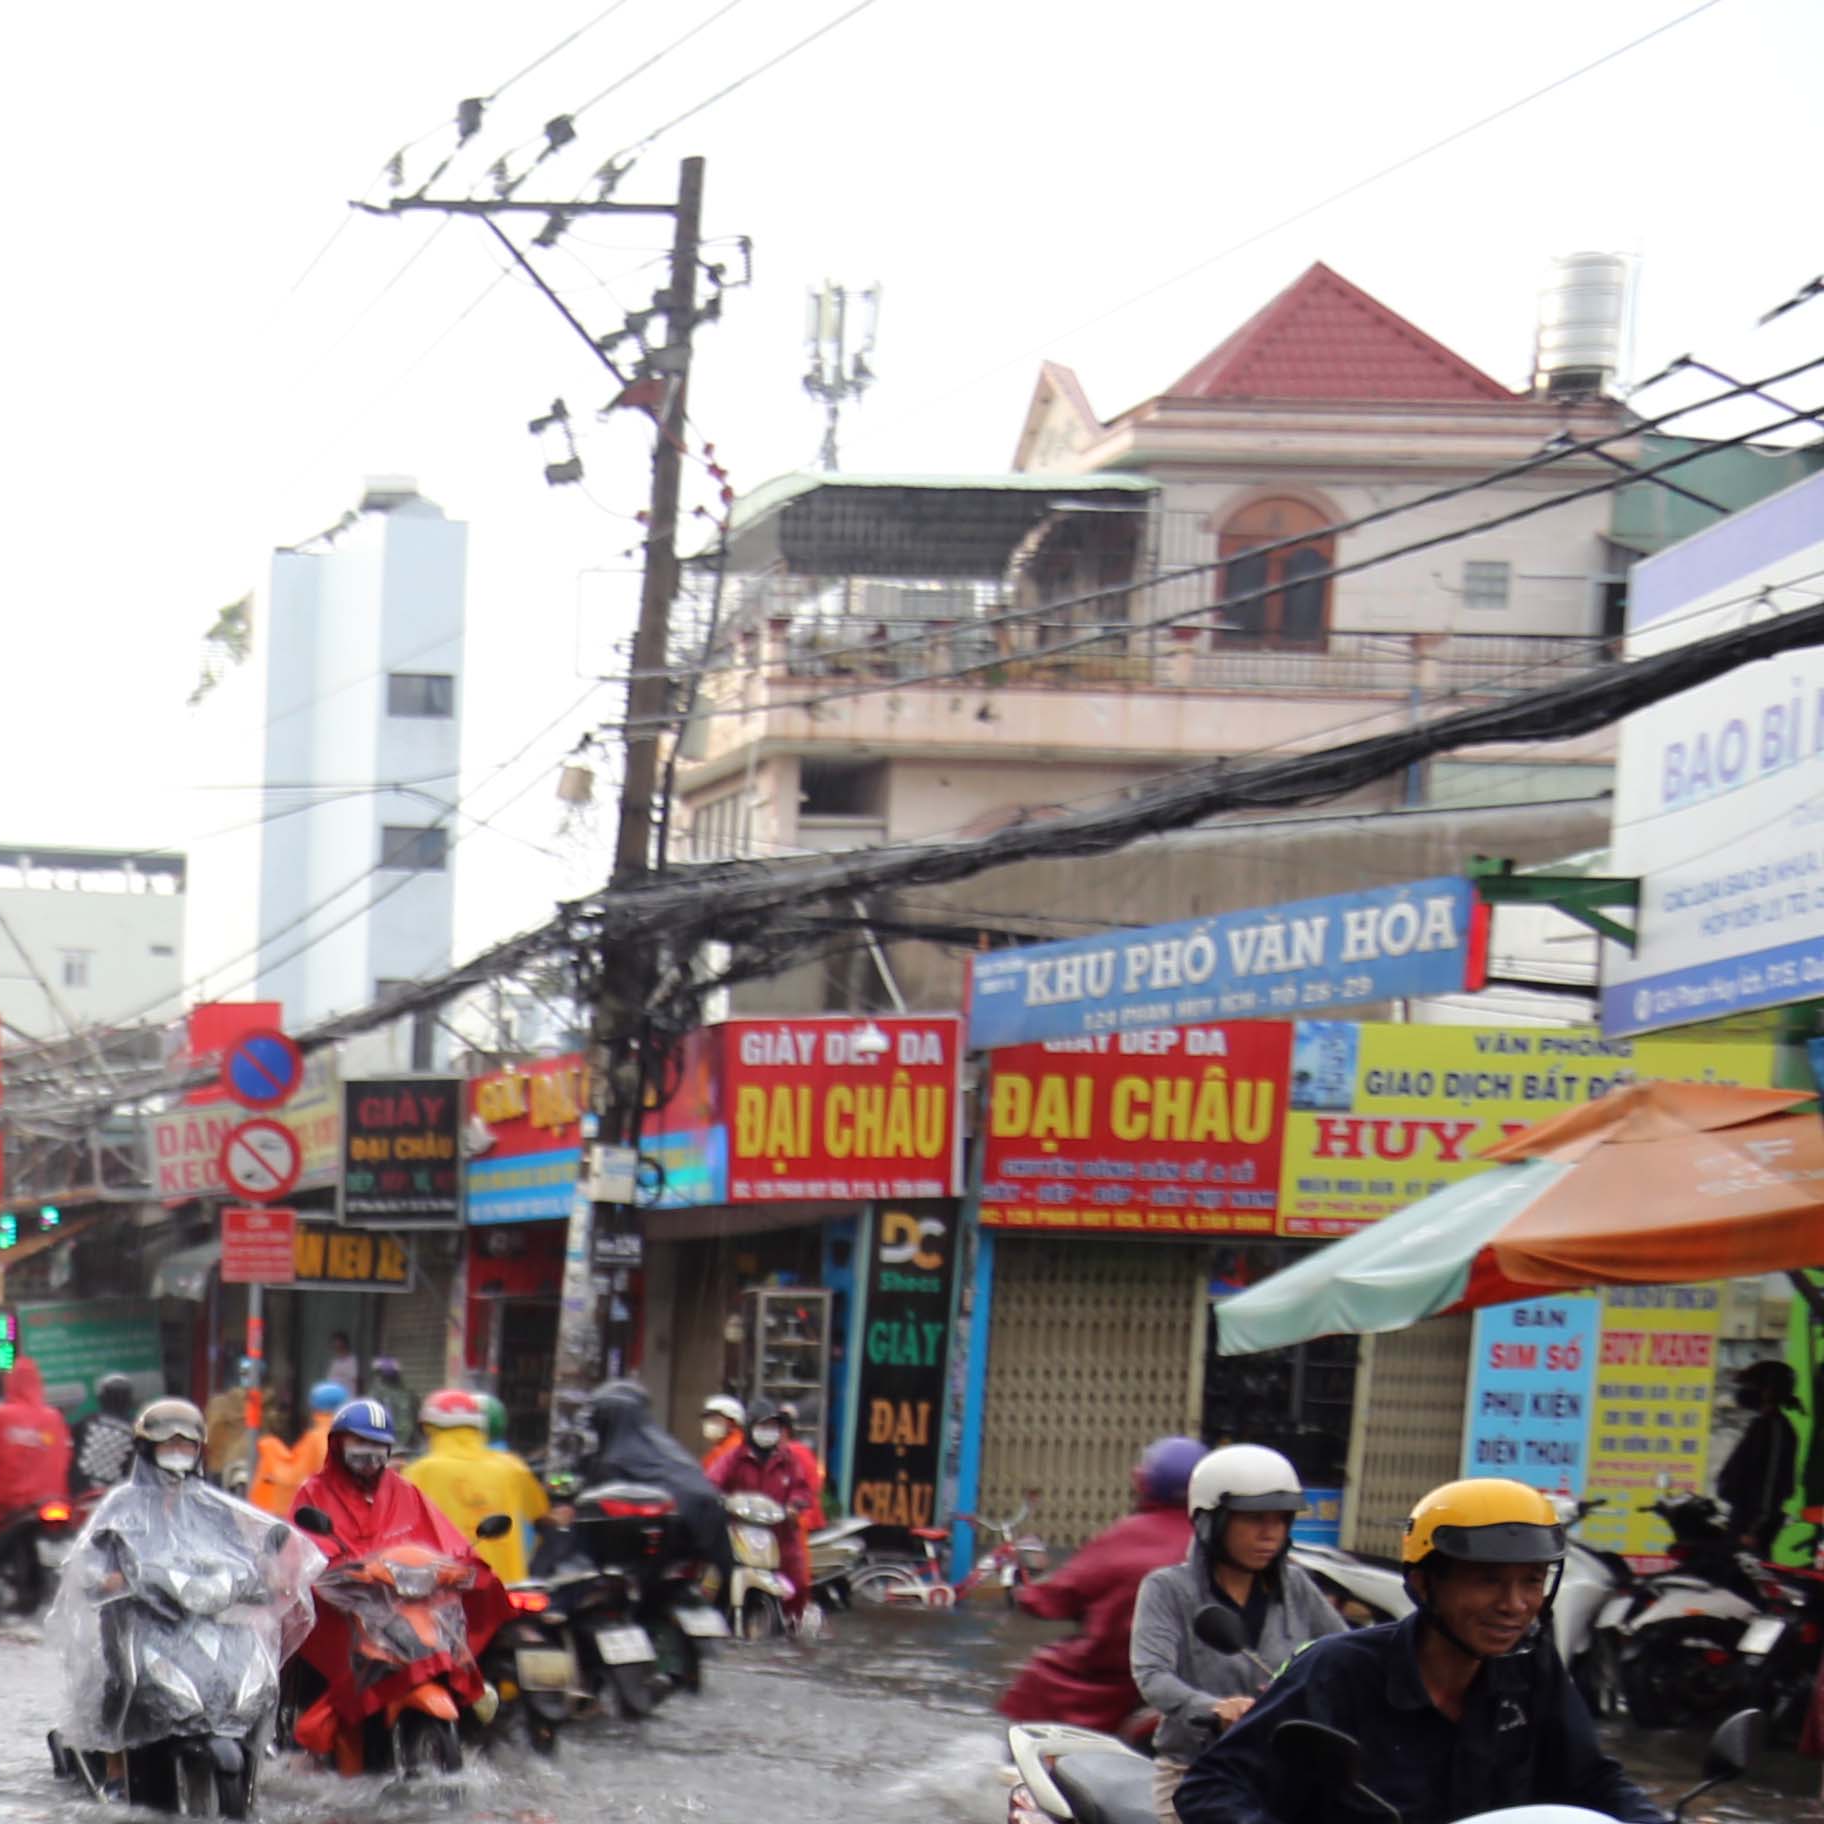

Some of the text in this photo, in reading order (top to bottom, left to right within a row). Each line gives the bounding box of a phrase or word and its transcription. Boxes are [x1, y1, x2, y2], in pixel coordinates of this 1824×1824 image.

[1661, 718, 1749, 805] BAO
[1024, 949, 1115, 1007] KHU
[1123, 919, 1218, 992] PHỐ
[1227, 912, 1328, 977] VĂN
[1340, 889, 1459, 964] HÓA
[739, 1025, 819, 1066] GIÀY
[897, 1031, 945, 1066] DA
[990, 1064, 1277, 1154] ĐẠI CHÂU
[1364, 1069, 1434, 1099] GIAO
[1442, 1070, 1513, 1108] DỊCH
[735, 1068, 947, 1176] ĐẠI CHÂU
[1311, 1116, 1480, 1161] HUY
[877, 1211, 948, 1271] DC
[866, 1308, 943, 1367] GIÀY
[1488, 1331, 1585, 1371] SIM SỐ
[866, 1397, 932, 1457] ĐẠI
